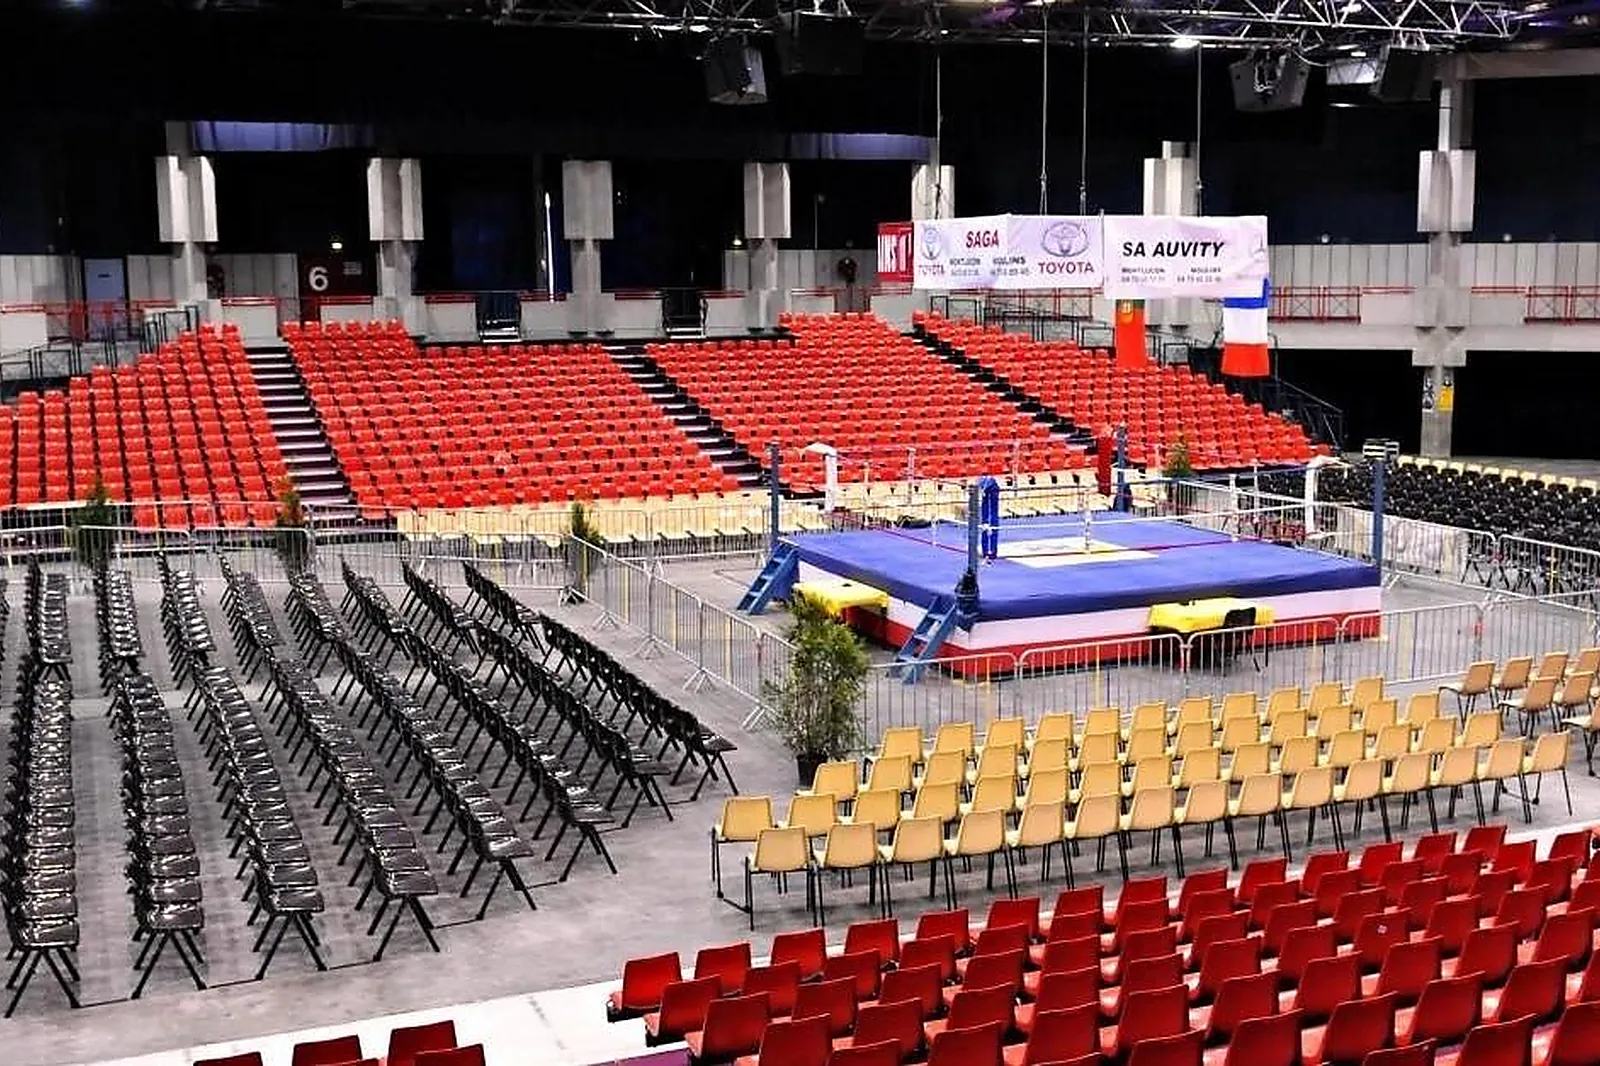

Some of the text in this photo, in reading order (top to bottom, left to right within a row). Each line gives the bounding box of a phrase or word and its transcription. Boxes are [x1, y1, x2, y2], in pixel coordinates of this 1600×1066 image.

[966, 229, 1000, 249] SAGA
[1122, 241, 1225, 257] SA AUVITY
[1038, 261, 1094, 274] TOYOTA
[309, 266, 329, 291] 6
